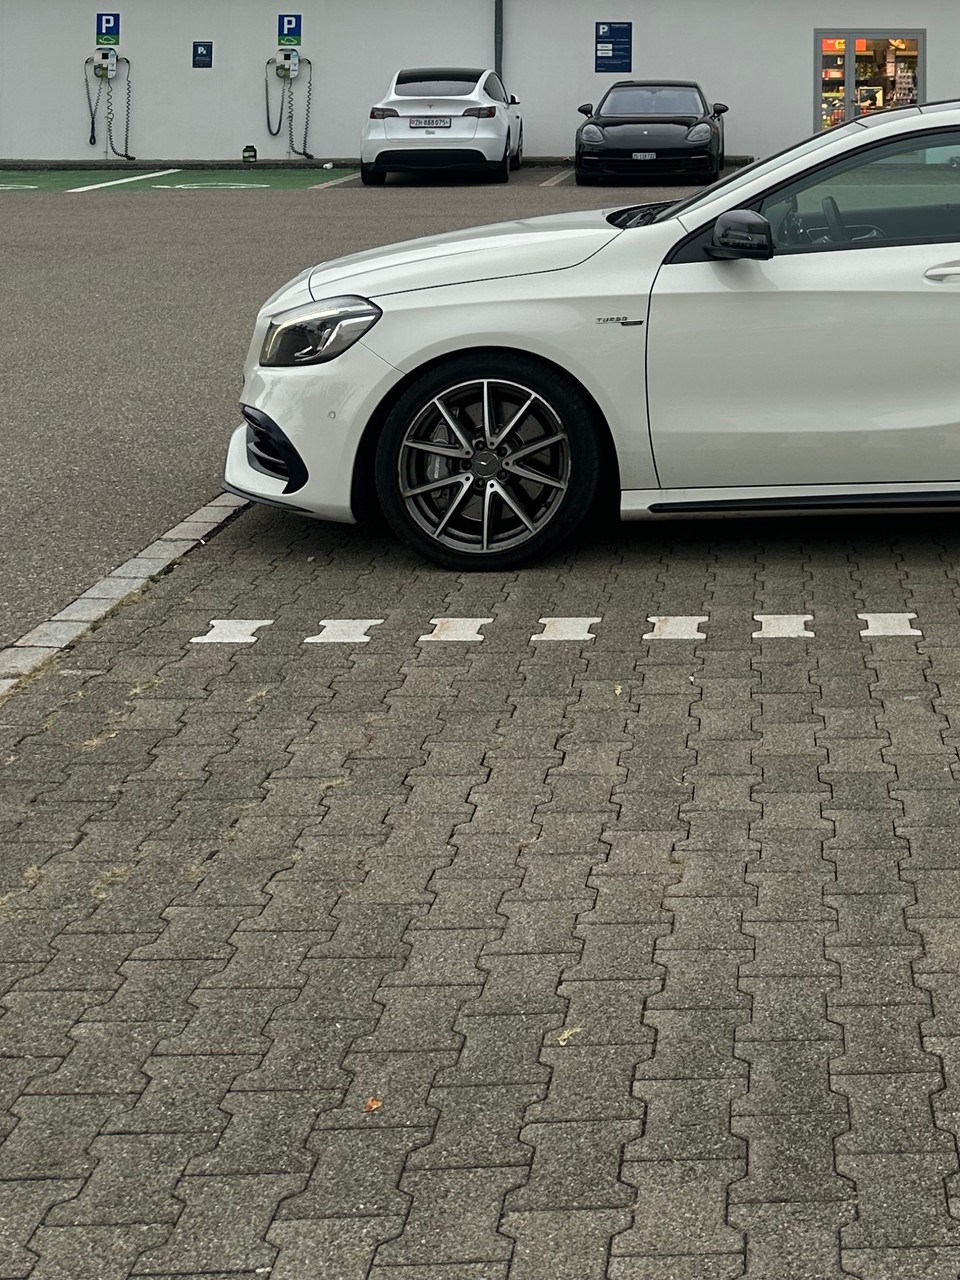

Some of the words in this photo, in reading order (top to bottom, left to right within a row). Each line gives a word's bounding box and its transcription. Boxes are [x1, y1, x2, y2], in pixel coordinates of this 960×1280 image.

[102, 15, 114, 33] P
[283, 17, 296, 34] P
[599, 25, 608, 35] P
